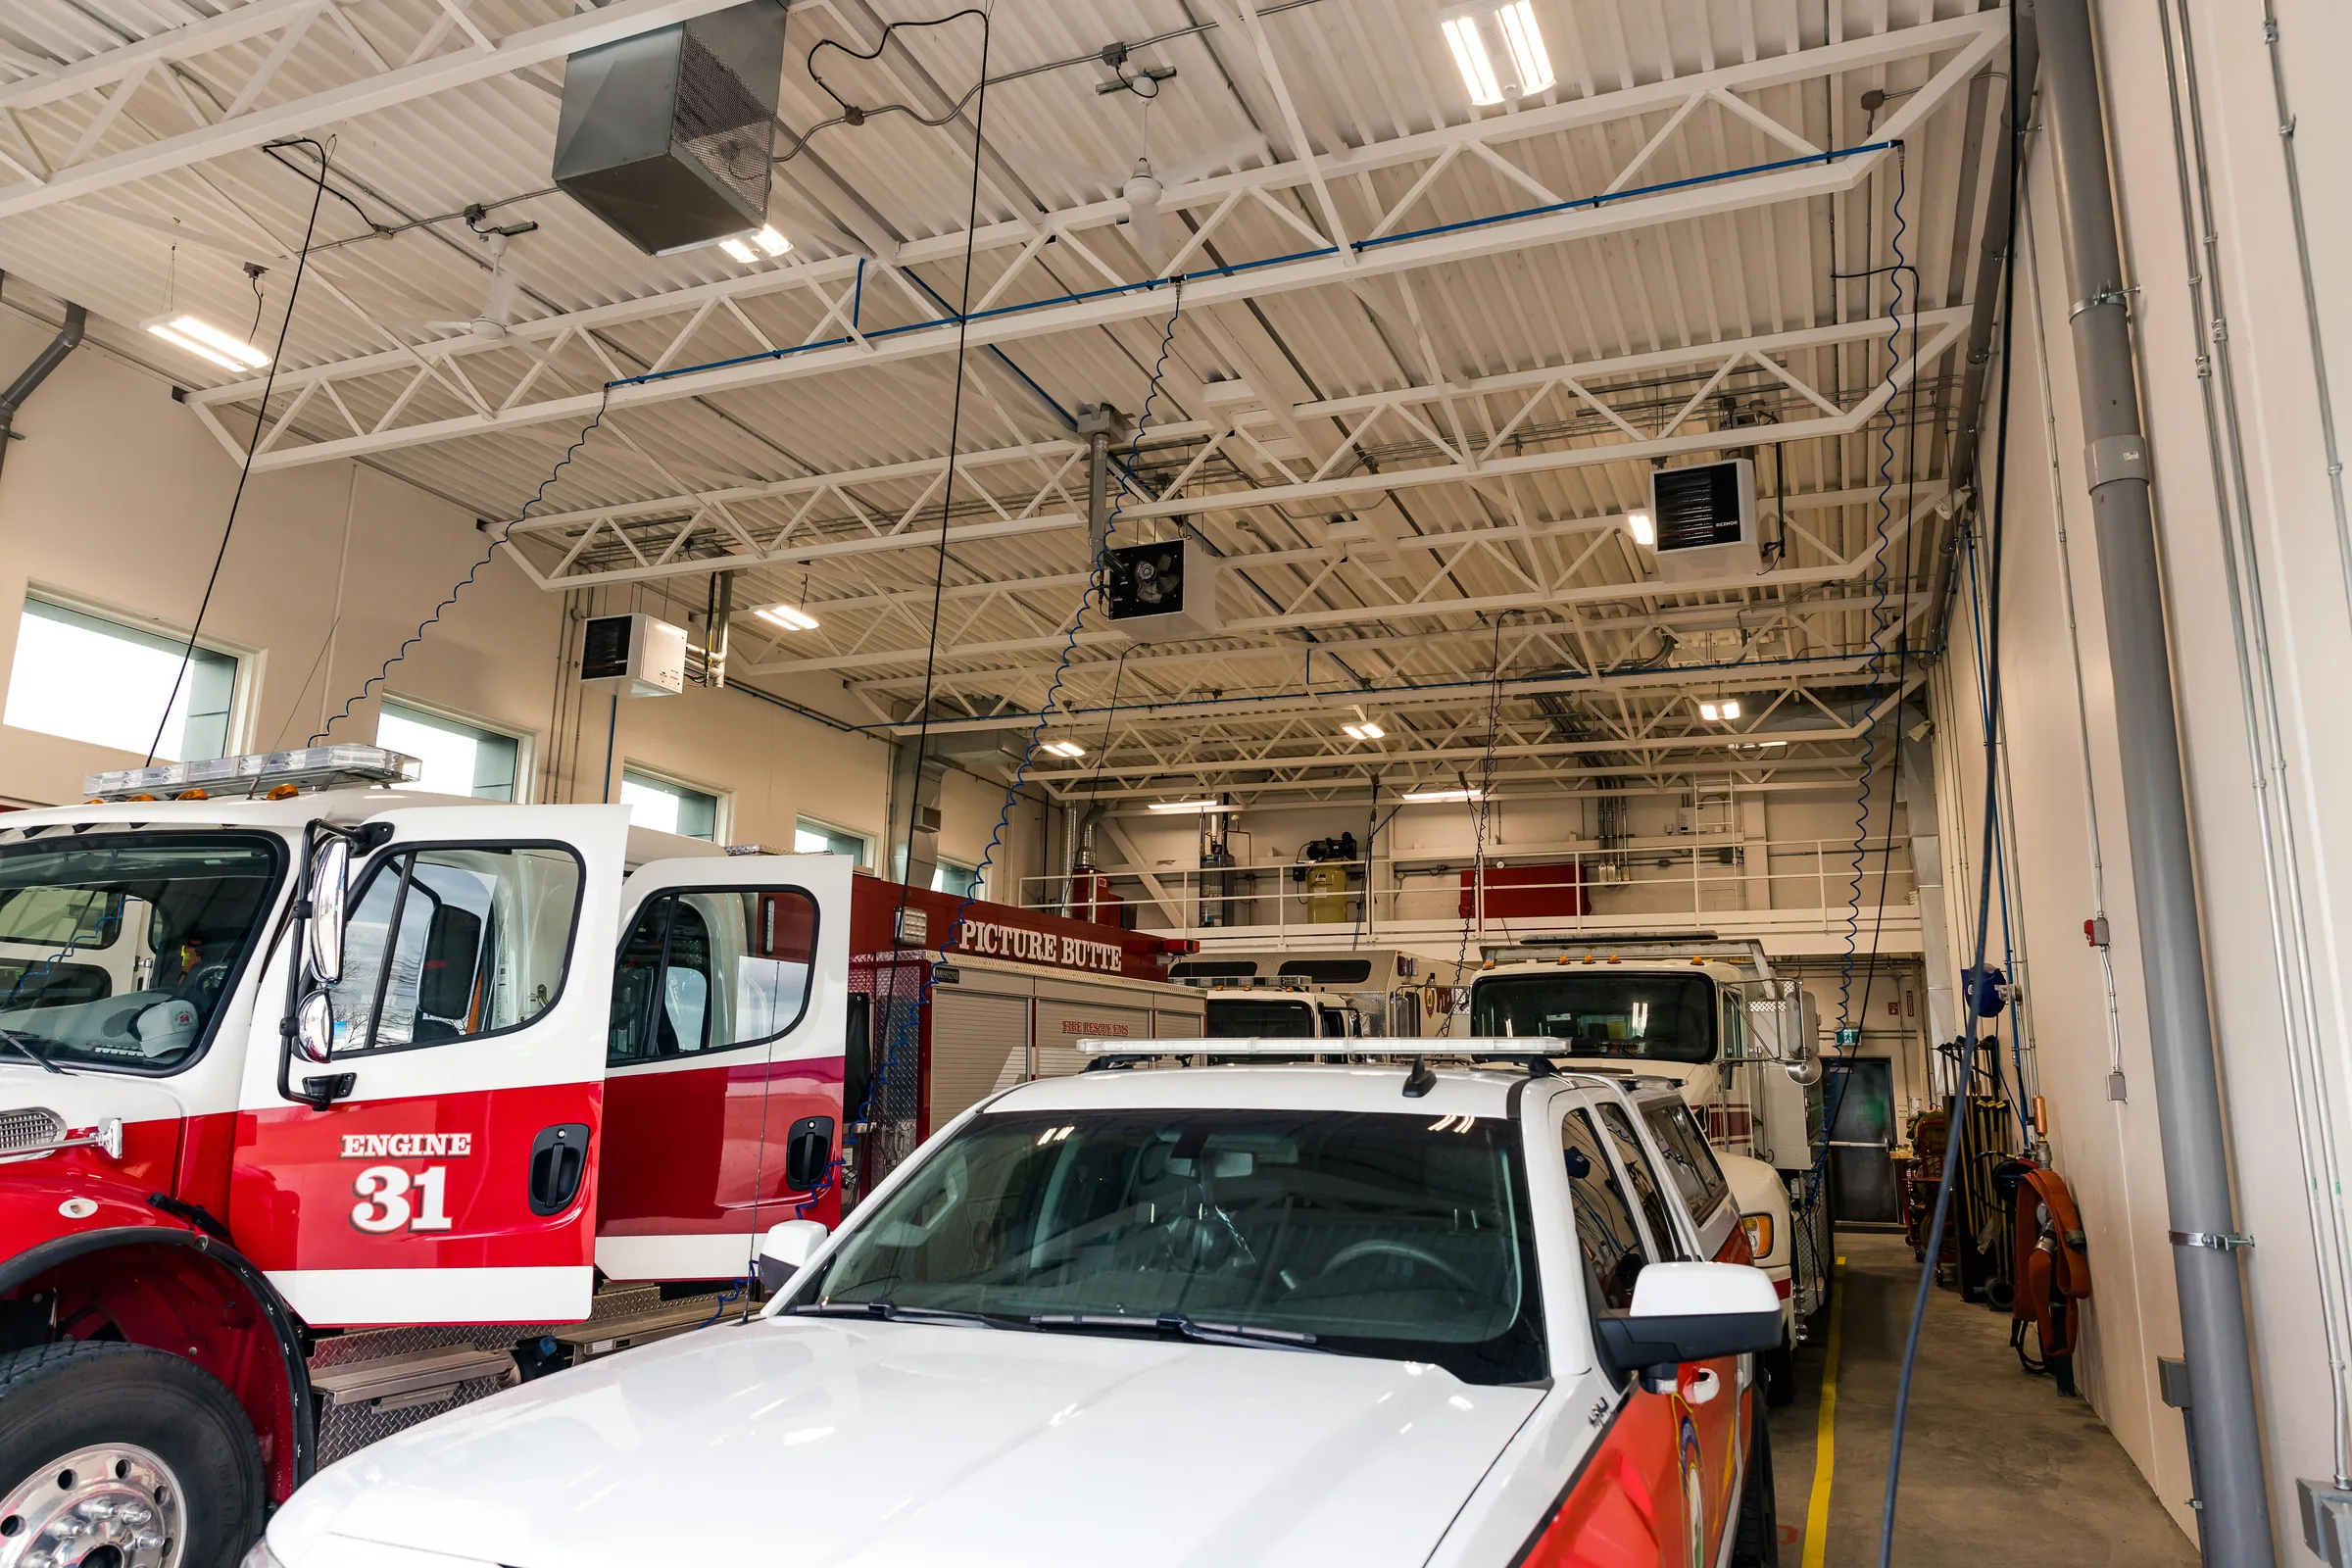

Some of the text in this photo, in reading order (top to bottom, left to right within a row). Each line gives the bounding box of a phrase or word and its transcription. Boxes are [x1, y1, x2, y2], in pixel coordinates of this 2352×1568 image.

[958, 919, 1122, 972] PICTURE BUTTE
[1062, 1021, 1129, 1036] FIRE RESCUE EMS
[339, 1133, 472, 1158] ENGINE
[350, 1165, 453, 1234] 31
